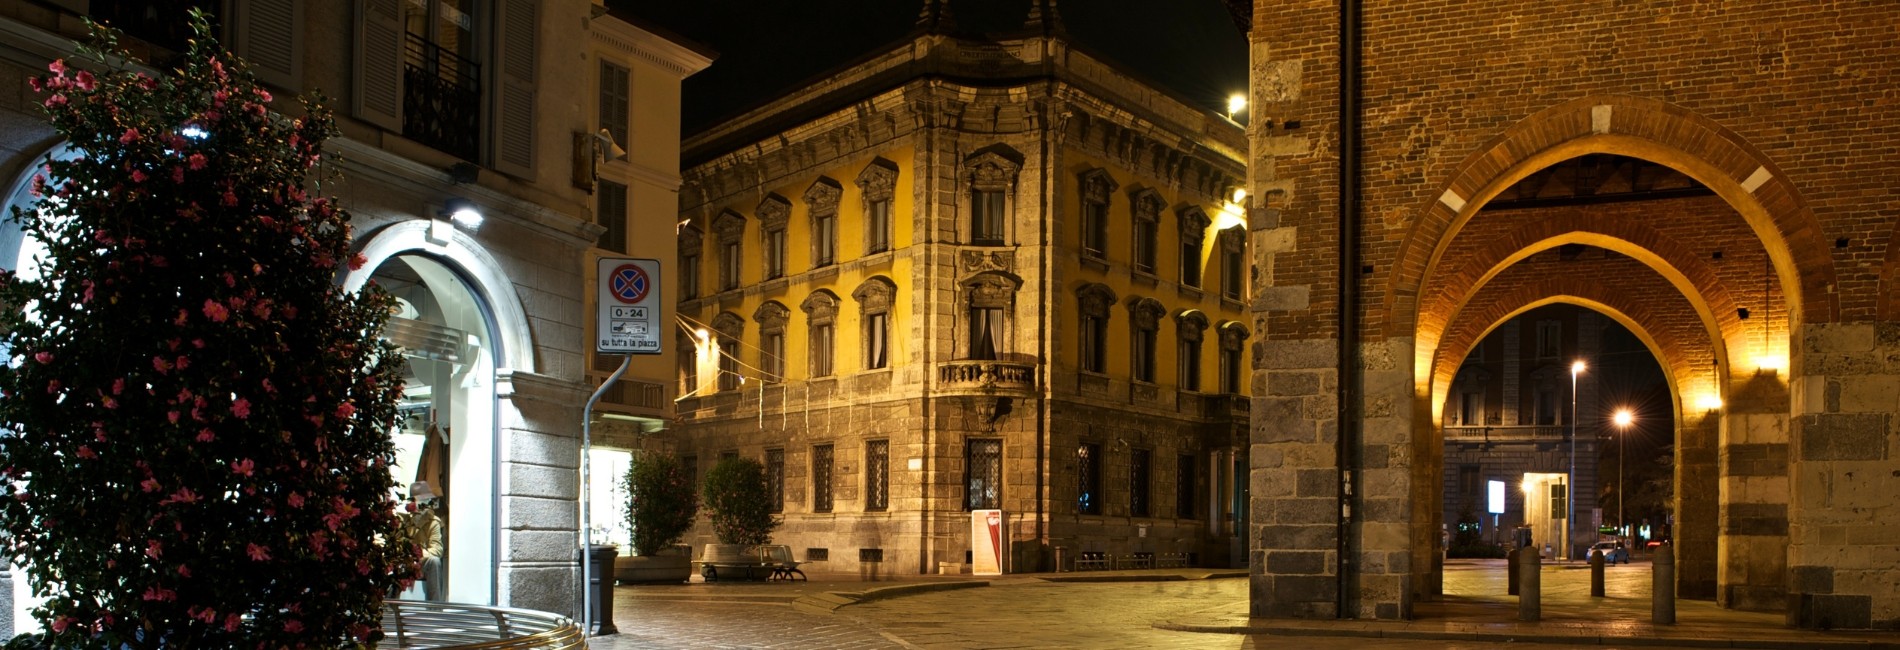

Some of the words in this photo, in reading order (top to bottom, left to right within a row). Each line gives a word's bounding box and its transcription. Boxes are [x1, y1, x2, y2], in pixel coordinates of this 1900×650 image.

[615, 308, 623, 317] 0
[630, 308, 643, 317] 24
[611, 338, 627, 347] tutta
[629, 338, 636, 347] la
[638, 339, 657, 348] piazza
